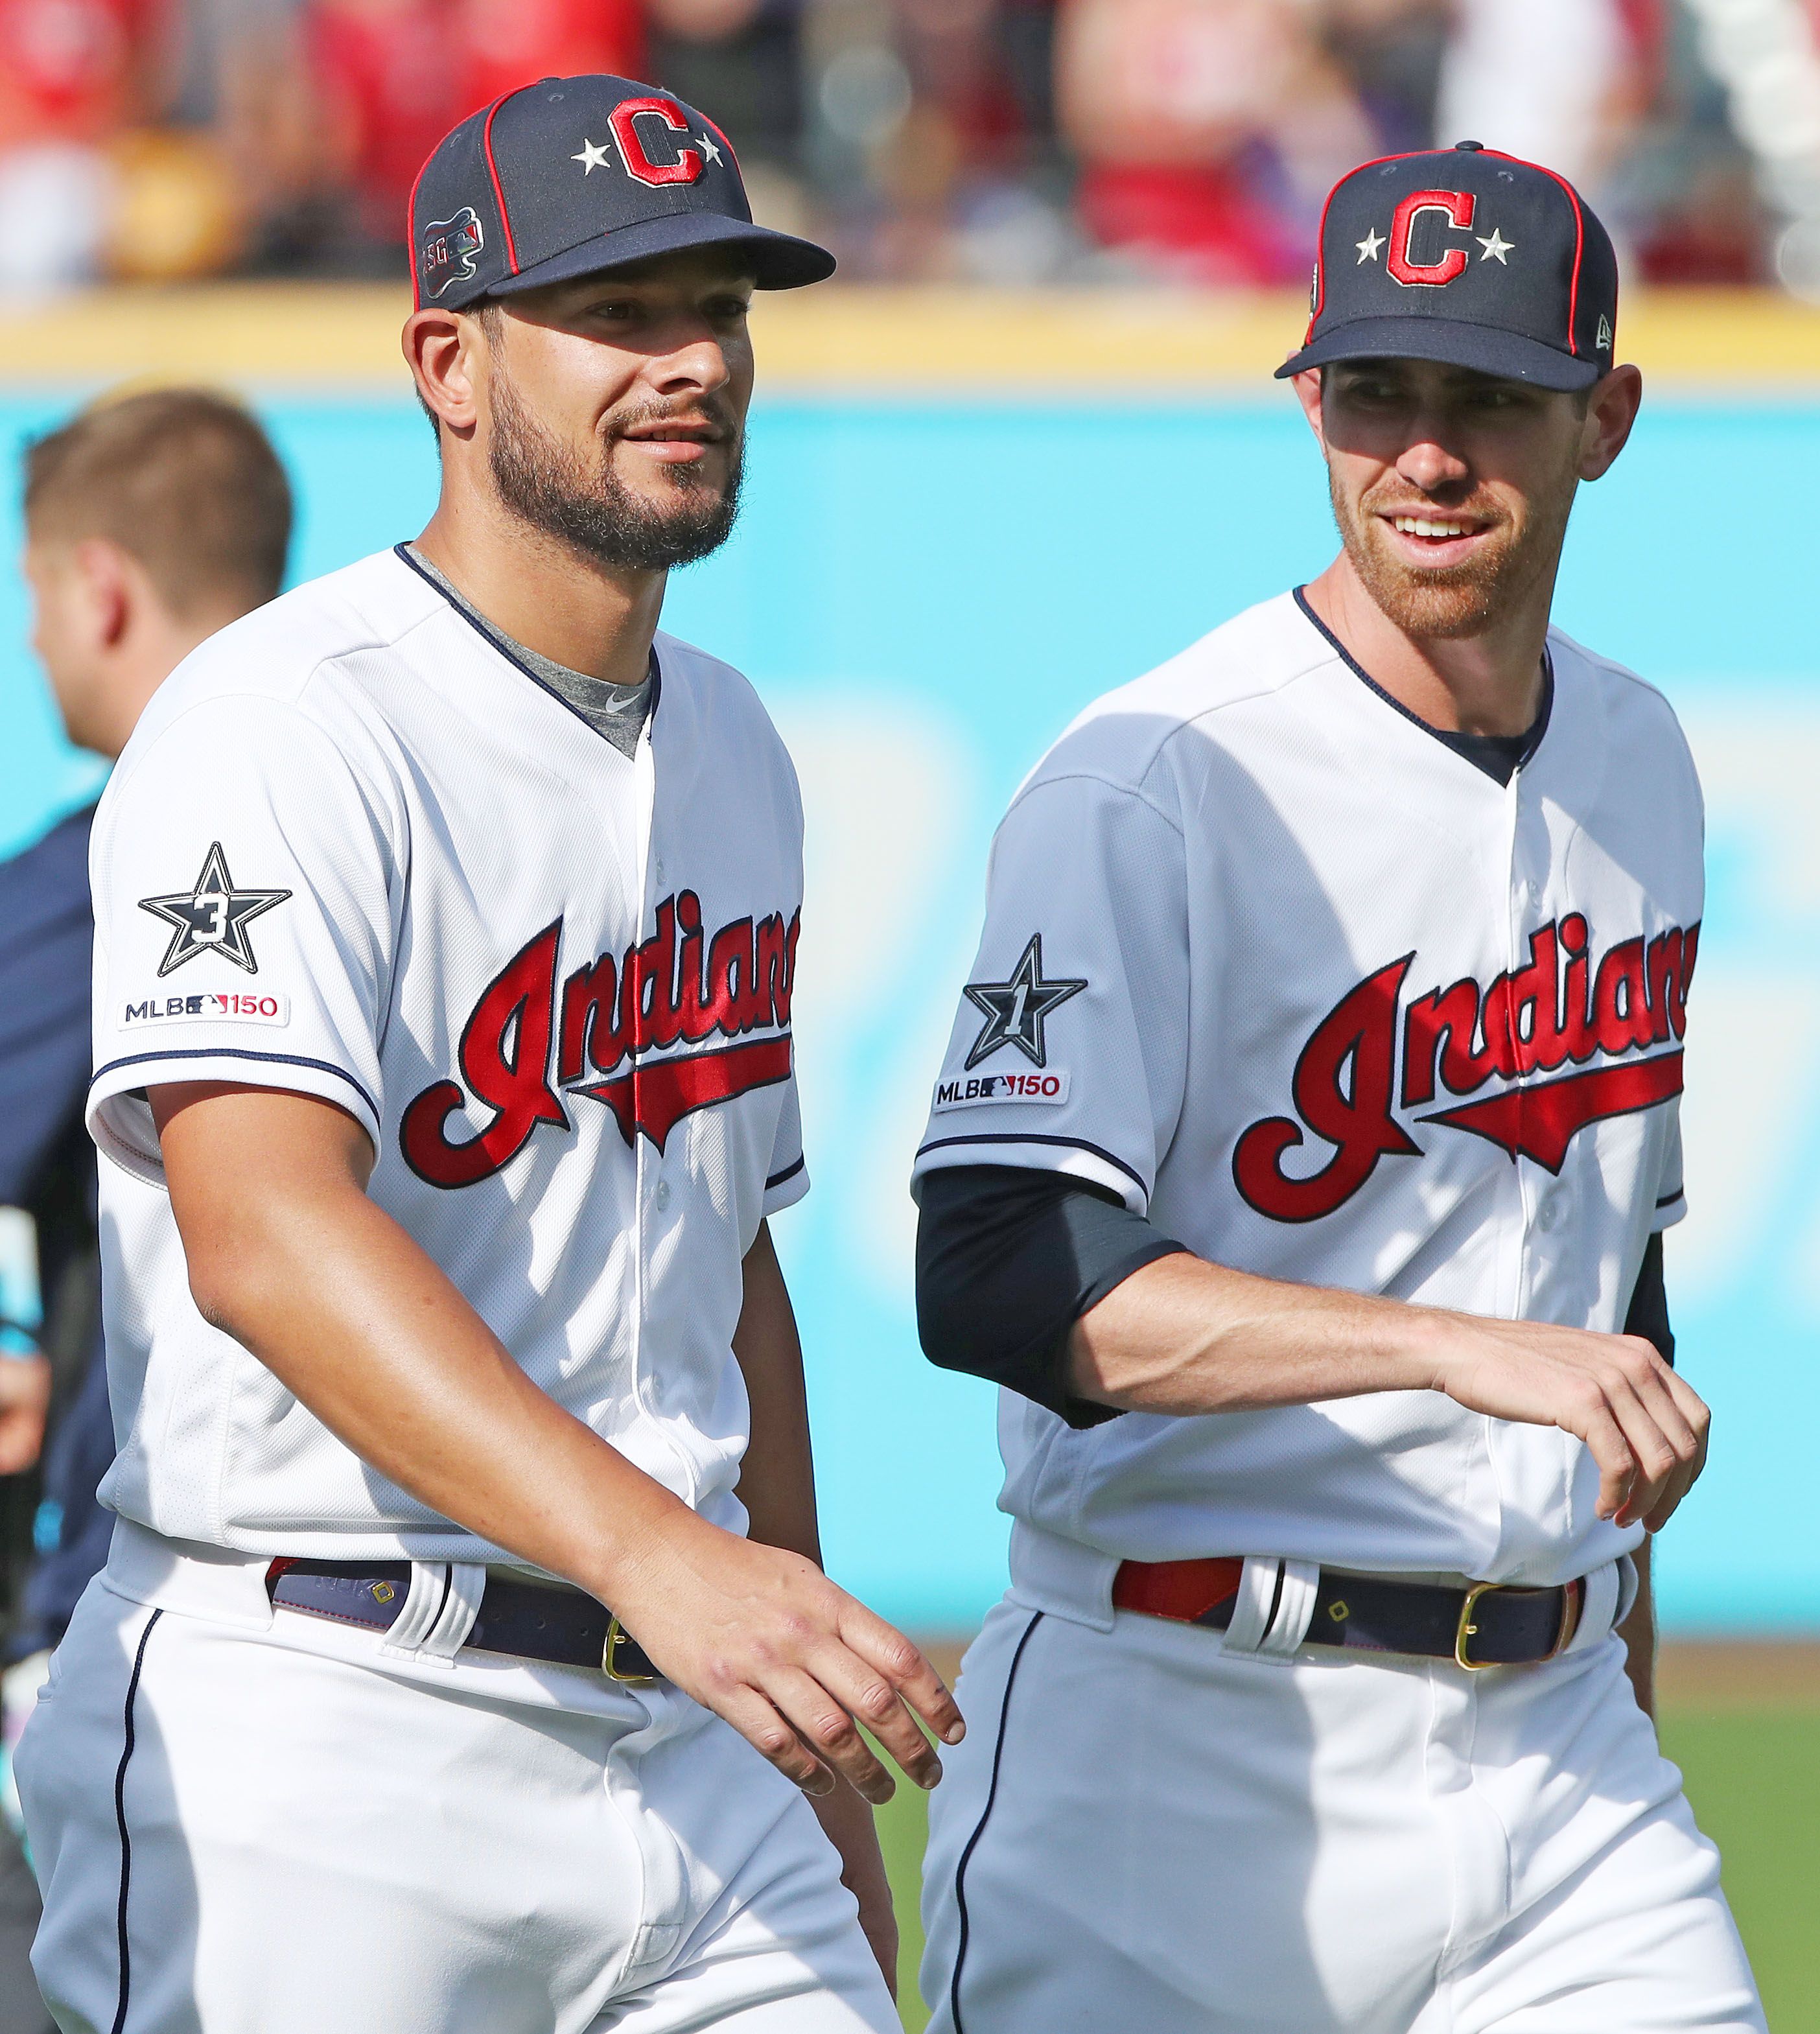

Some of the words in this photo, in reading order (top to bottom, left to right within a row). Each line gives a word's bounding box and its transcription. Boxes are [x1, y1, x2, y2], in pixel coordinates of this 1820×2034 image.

[607, 97, 703, 188] C
[423, 237, 449, 273] SG
[1386, 189, 1476, 288] C
[191, 244, 229, 295] 3
[125, 998, 184, 1022] MLB
[230, 994, 278, 1016] 150
[1004, 983, 1029, 1035] 1
[937, 1079, 980, 1105] MLB
[1017, 1075, 1060, 1096] 150
